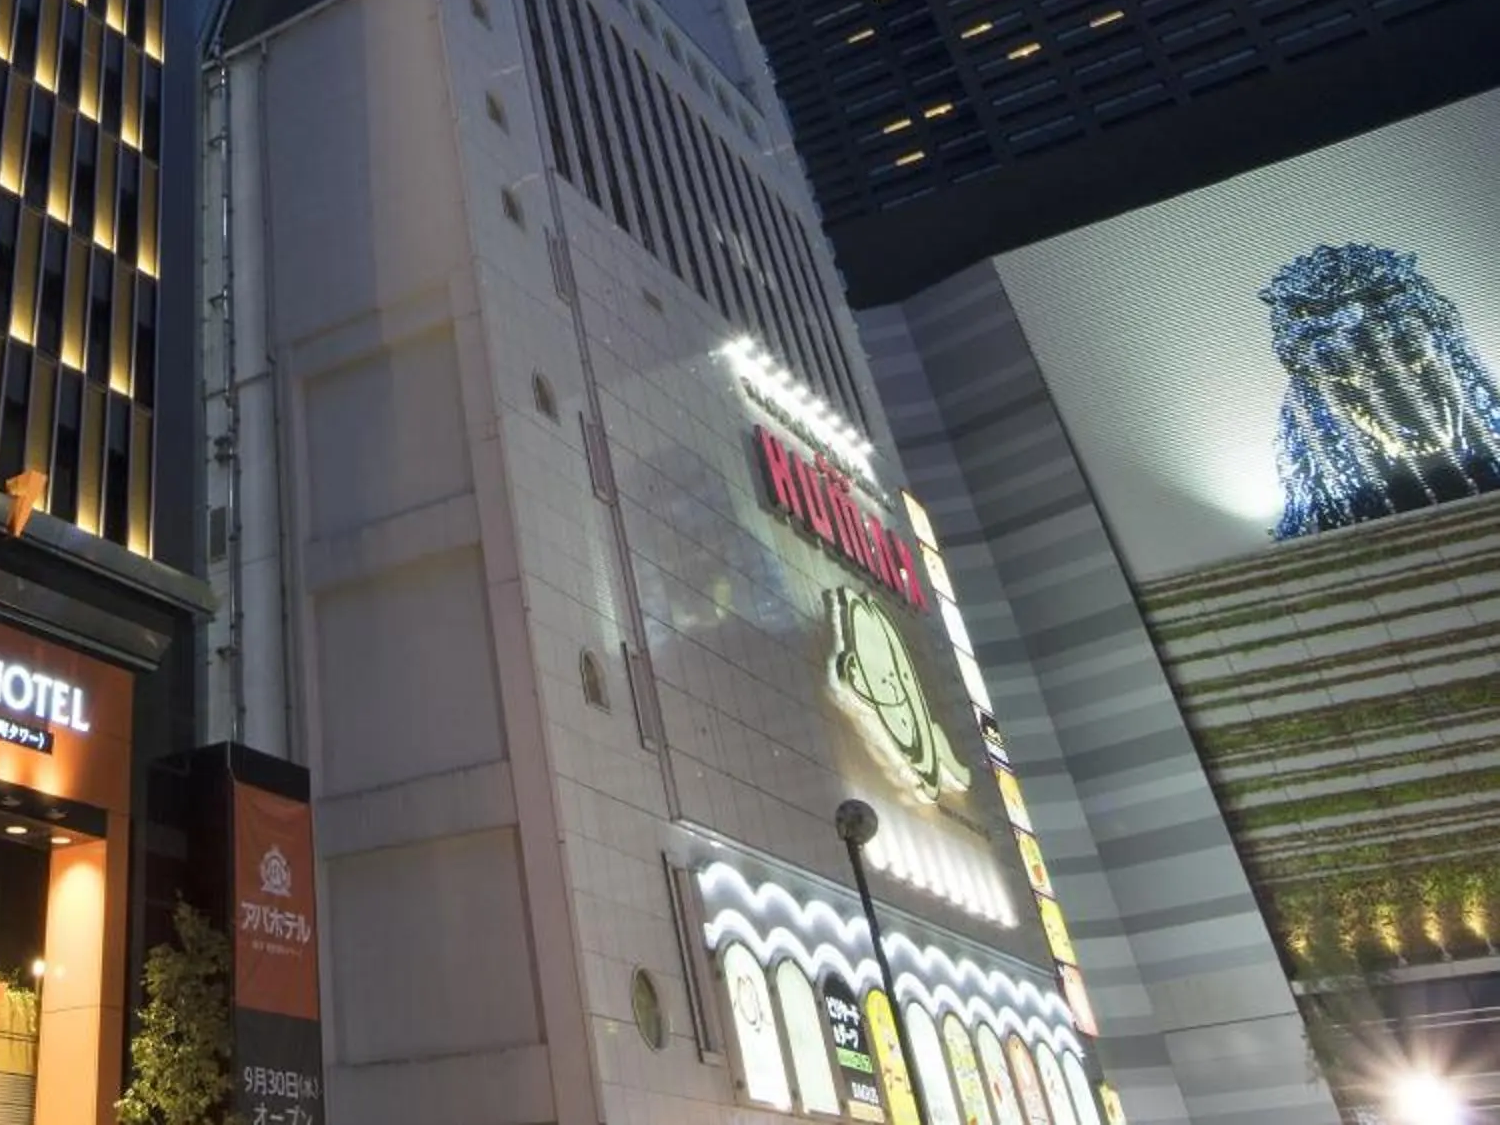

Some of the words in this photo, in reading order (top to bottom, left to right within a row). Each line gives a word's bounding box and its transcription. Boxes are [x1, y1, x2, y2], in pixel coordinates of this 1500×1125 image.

[240, 899, 311, 944] アパホテル
